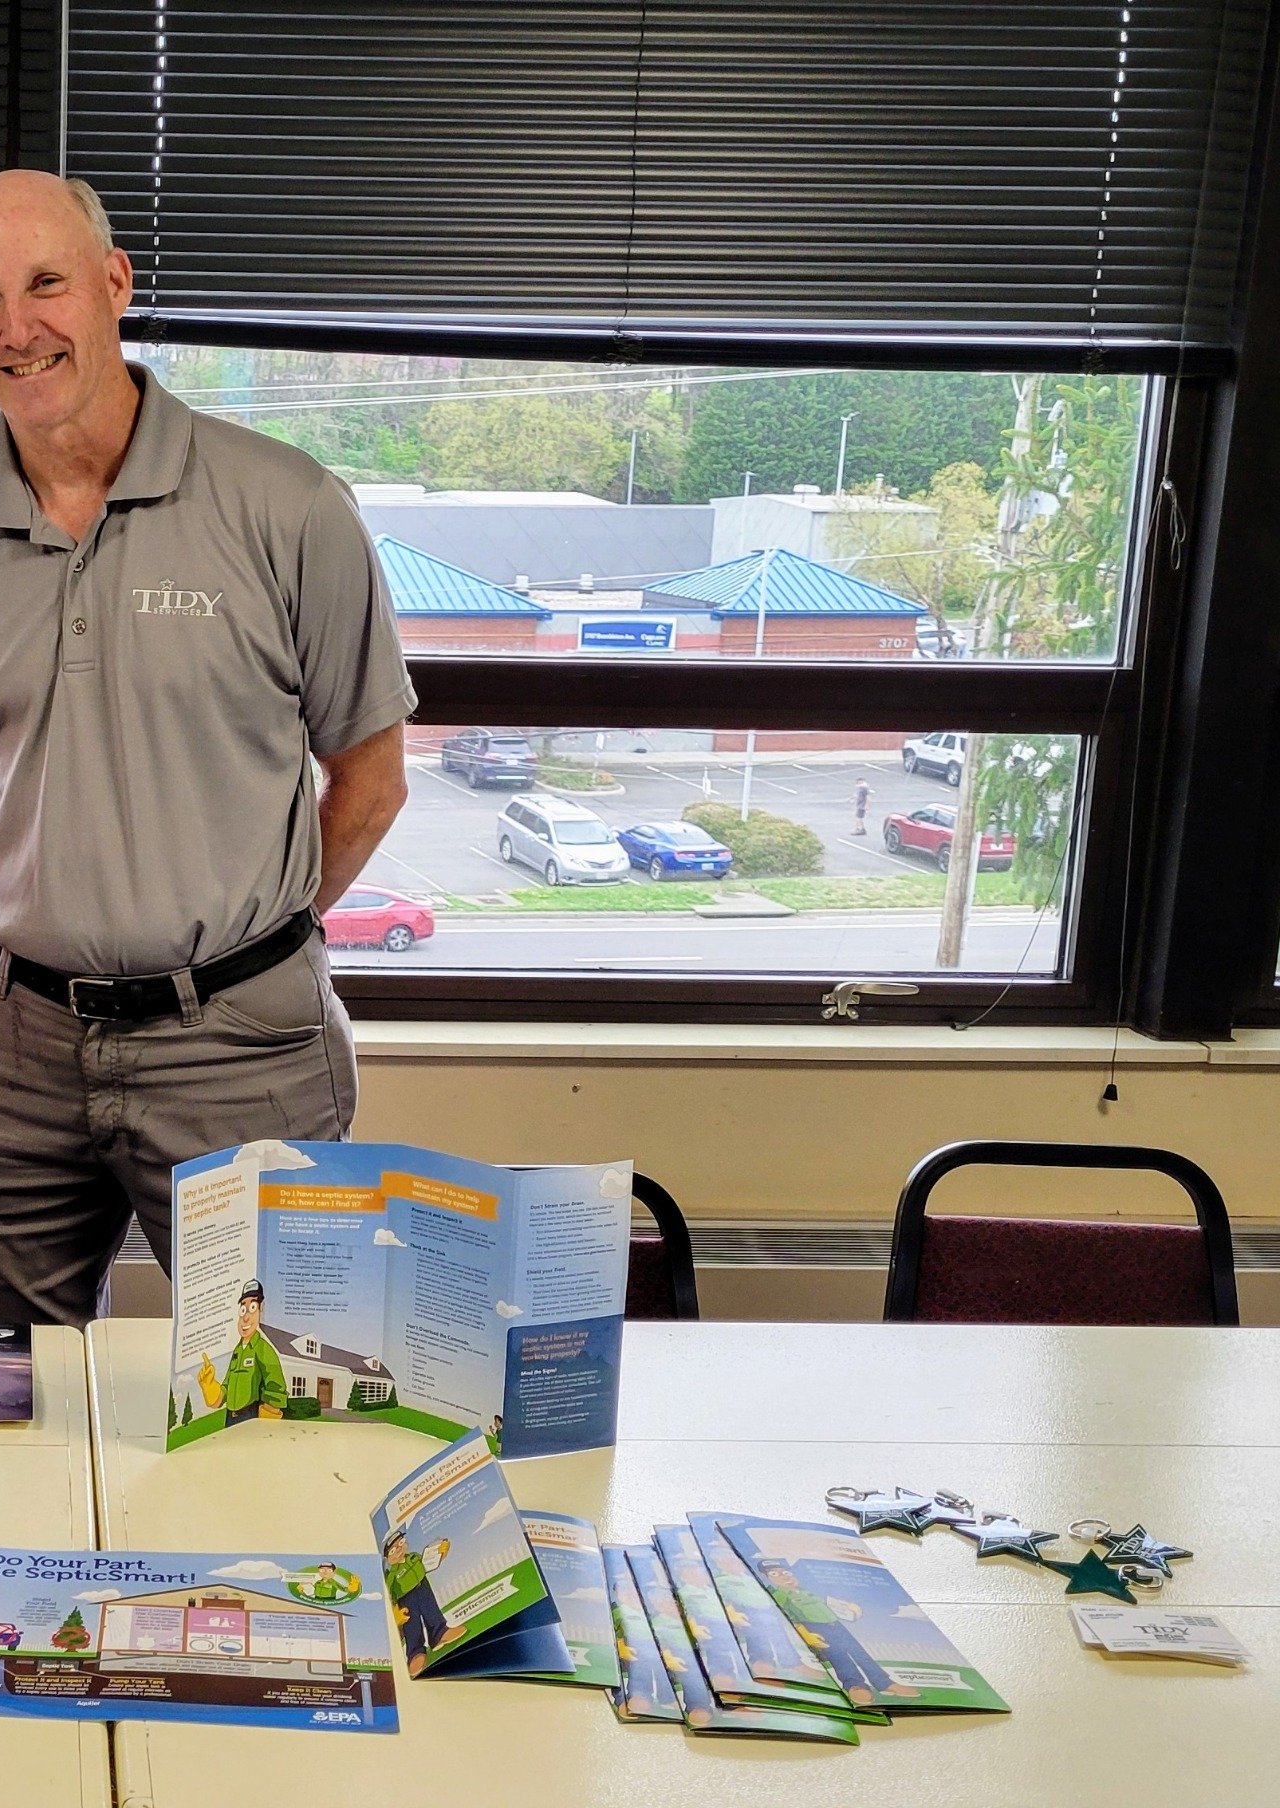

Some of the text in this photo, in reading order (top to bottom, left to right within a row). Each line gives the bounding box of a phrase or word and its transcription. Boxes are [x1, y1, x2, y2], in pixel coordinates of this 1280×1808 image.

[132, 589, 223, 617] TIDY
[153, 607, 201, 616] SERVICES
[879, 638, 909, 649] 3707
[190, 1194, 217, 1210] properly
[217, 1185, 246, 1200] maintain
[321, 1191, 344, 1199] septic
[344, 1192, 374, 1200] system?
[412, 1180, 430, 1190] What
[430, 1186, 443, 1194] can
[465, 1194, 480, 1204] help
[412, 1190, 478, 1211] maintain my system?
[399, 1500, 411, 1512] Be
[413, 1452, 480, 1500] SepticSmart!
[27, 1555, 87, 1570] Your
[94, 1558, 152, 1571] Part.
[25, 1567, 196, 1584] SepticSmart!
[1132, 1625, 1191, 1636] TIDY
[328, 1712, 362, 1722] EPA
